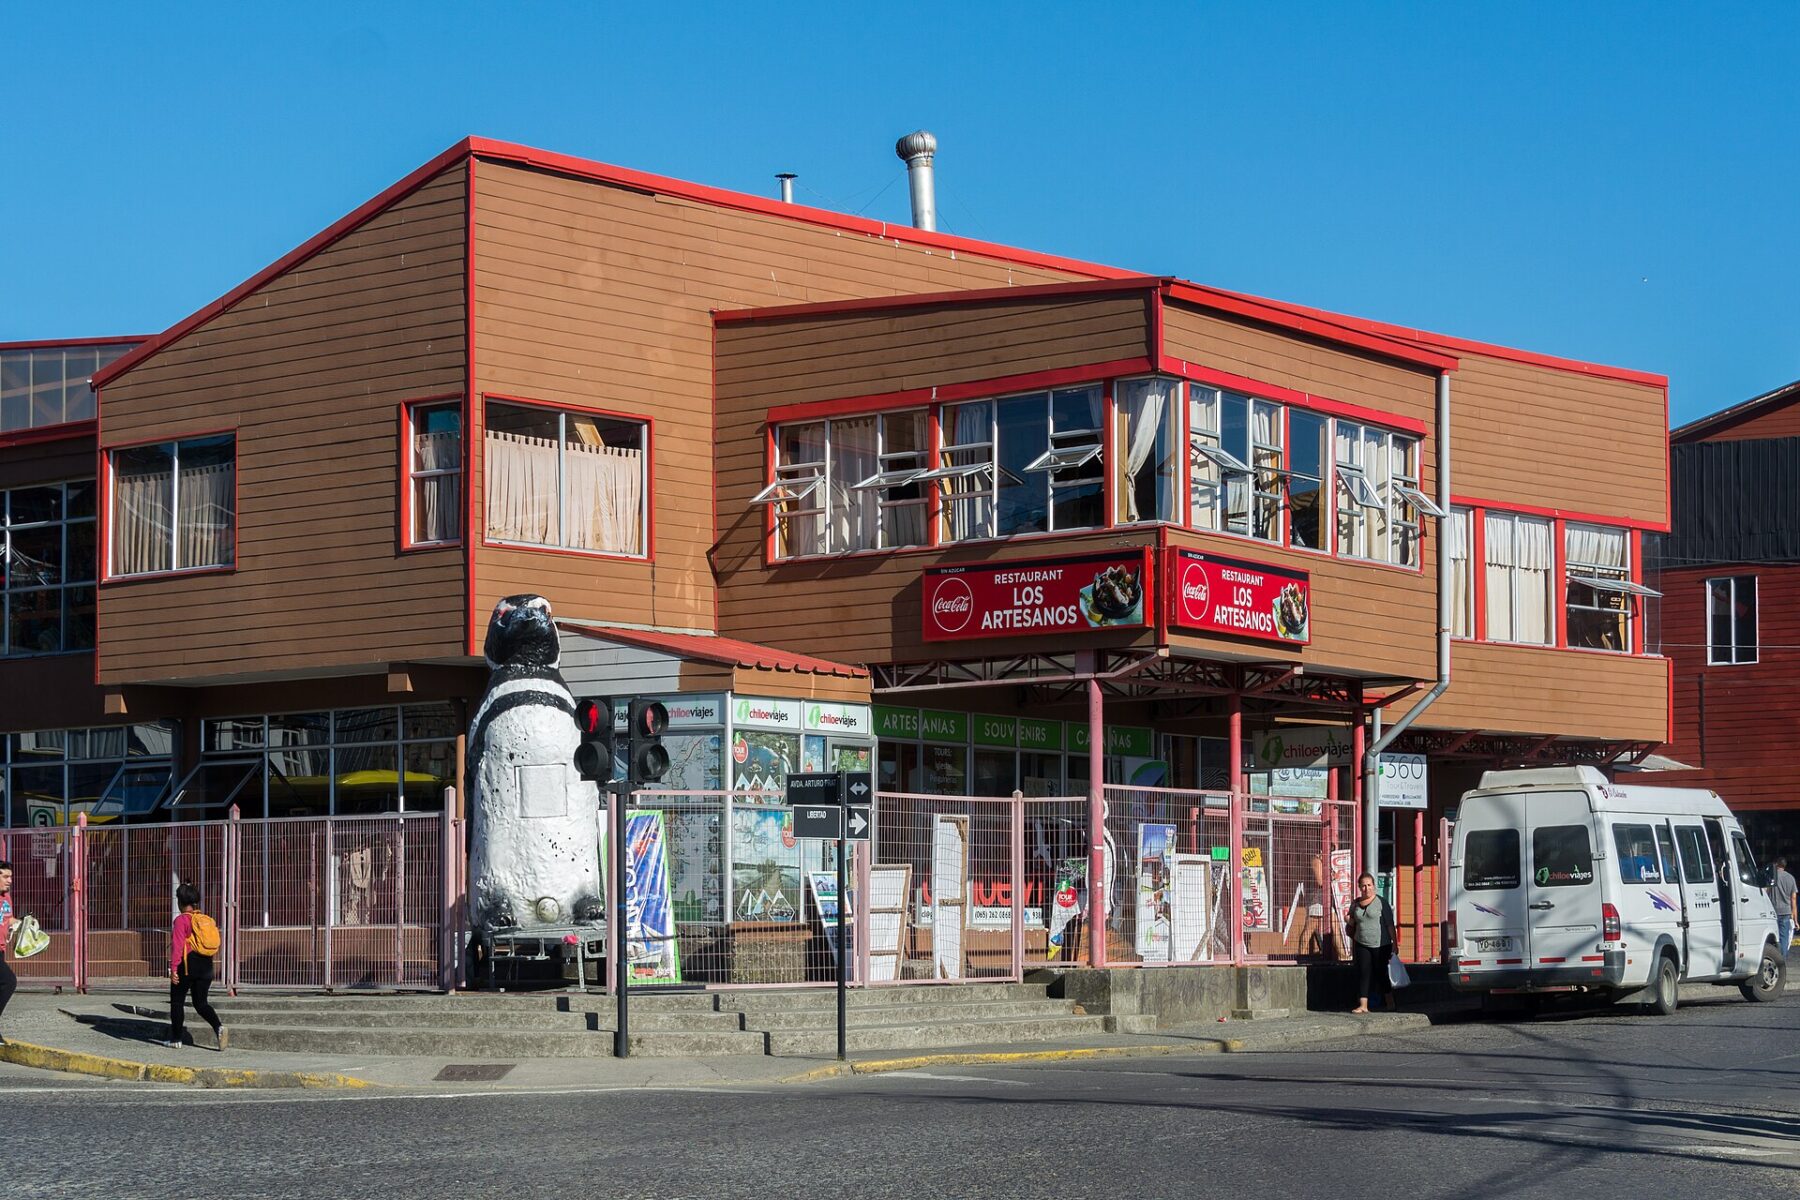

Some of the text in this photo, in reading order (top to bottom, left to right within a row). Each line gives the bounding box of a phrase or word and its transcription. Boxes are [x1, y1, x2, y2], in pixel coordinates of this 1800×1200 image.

[994, 570, 1063, 585] RESTAURANT
[1221, 569, 1264, 587] RESTAURANT
[1013, 585, 1043, 606] LOS
[1233, 586, 1252, 607] LOS
[981, 605, 1078, 630] ARTESANOS
[1213, 604, 1272, 632] ARTESANOS
[749, 709, 788, 722] chiloeviajes
[820, 713, 857, 727] chiloeviajes
[882, 713, 956, 735] ARTESANIAS
[984, 722, 1047, 743] SOUVENIRS
[1386, 755, 1424, 779] 360
[804, 779, 823, 787] ARTURO
[806, 810, 827, 819] LIBERTAD
